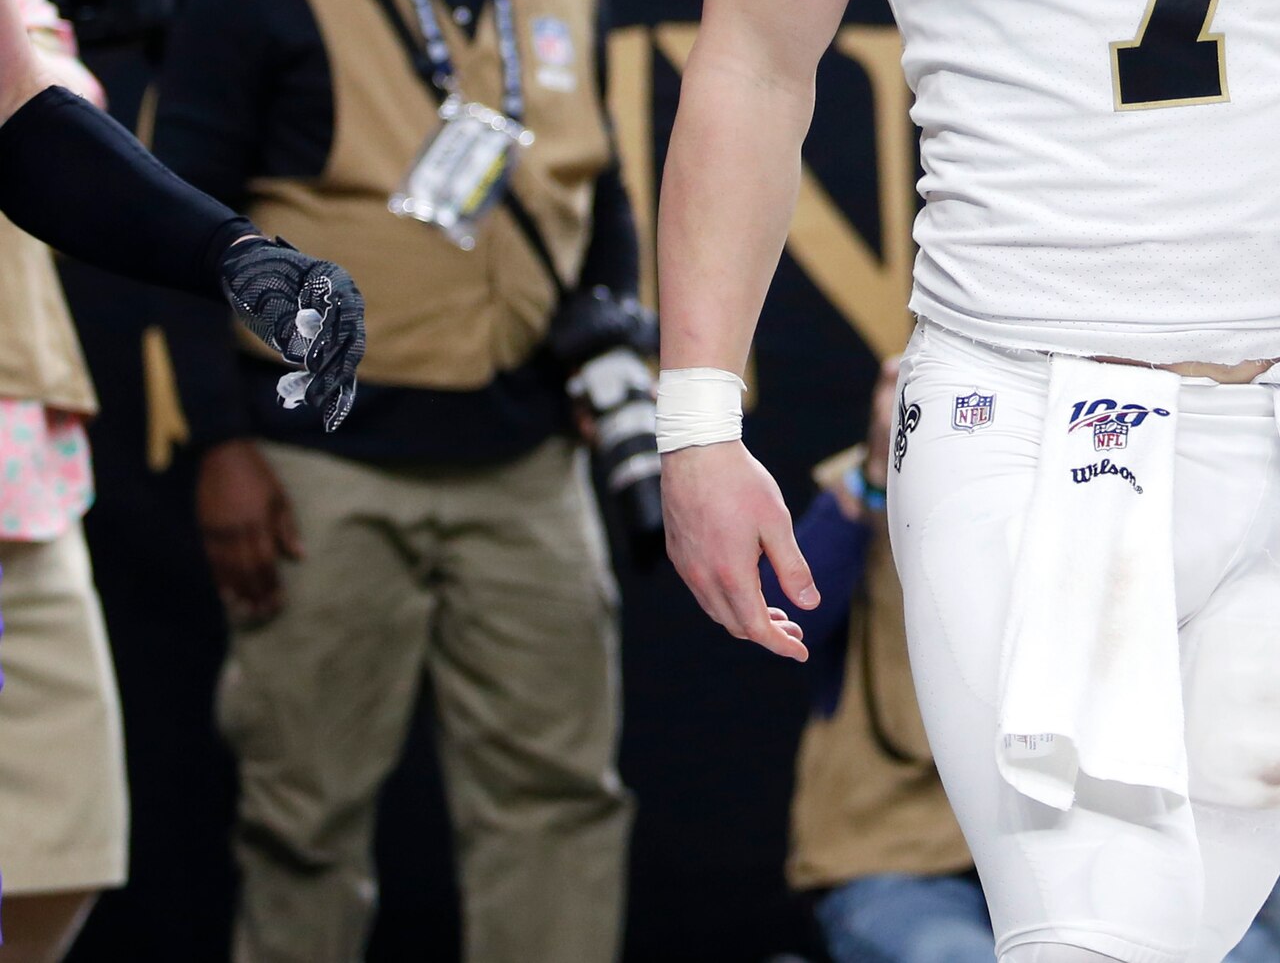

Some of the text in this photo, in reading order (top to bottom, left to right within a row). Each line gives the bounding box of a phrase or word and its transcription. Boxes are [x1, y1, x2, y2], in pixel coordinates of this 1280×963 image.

[959, 407, 987, 425] NFL
[1096, 433, 1123, 448] NFL
[1070, 458, 1136, 484] Wilson
